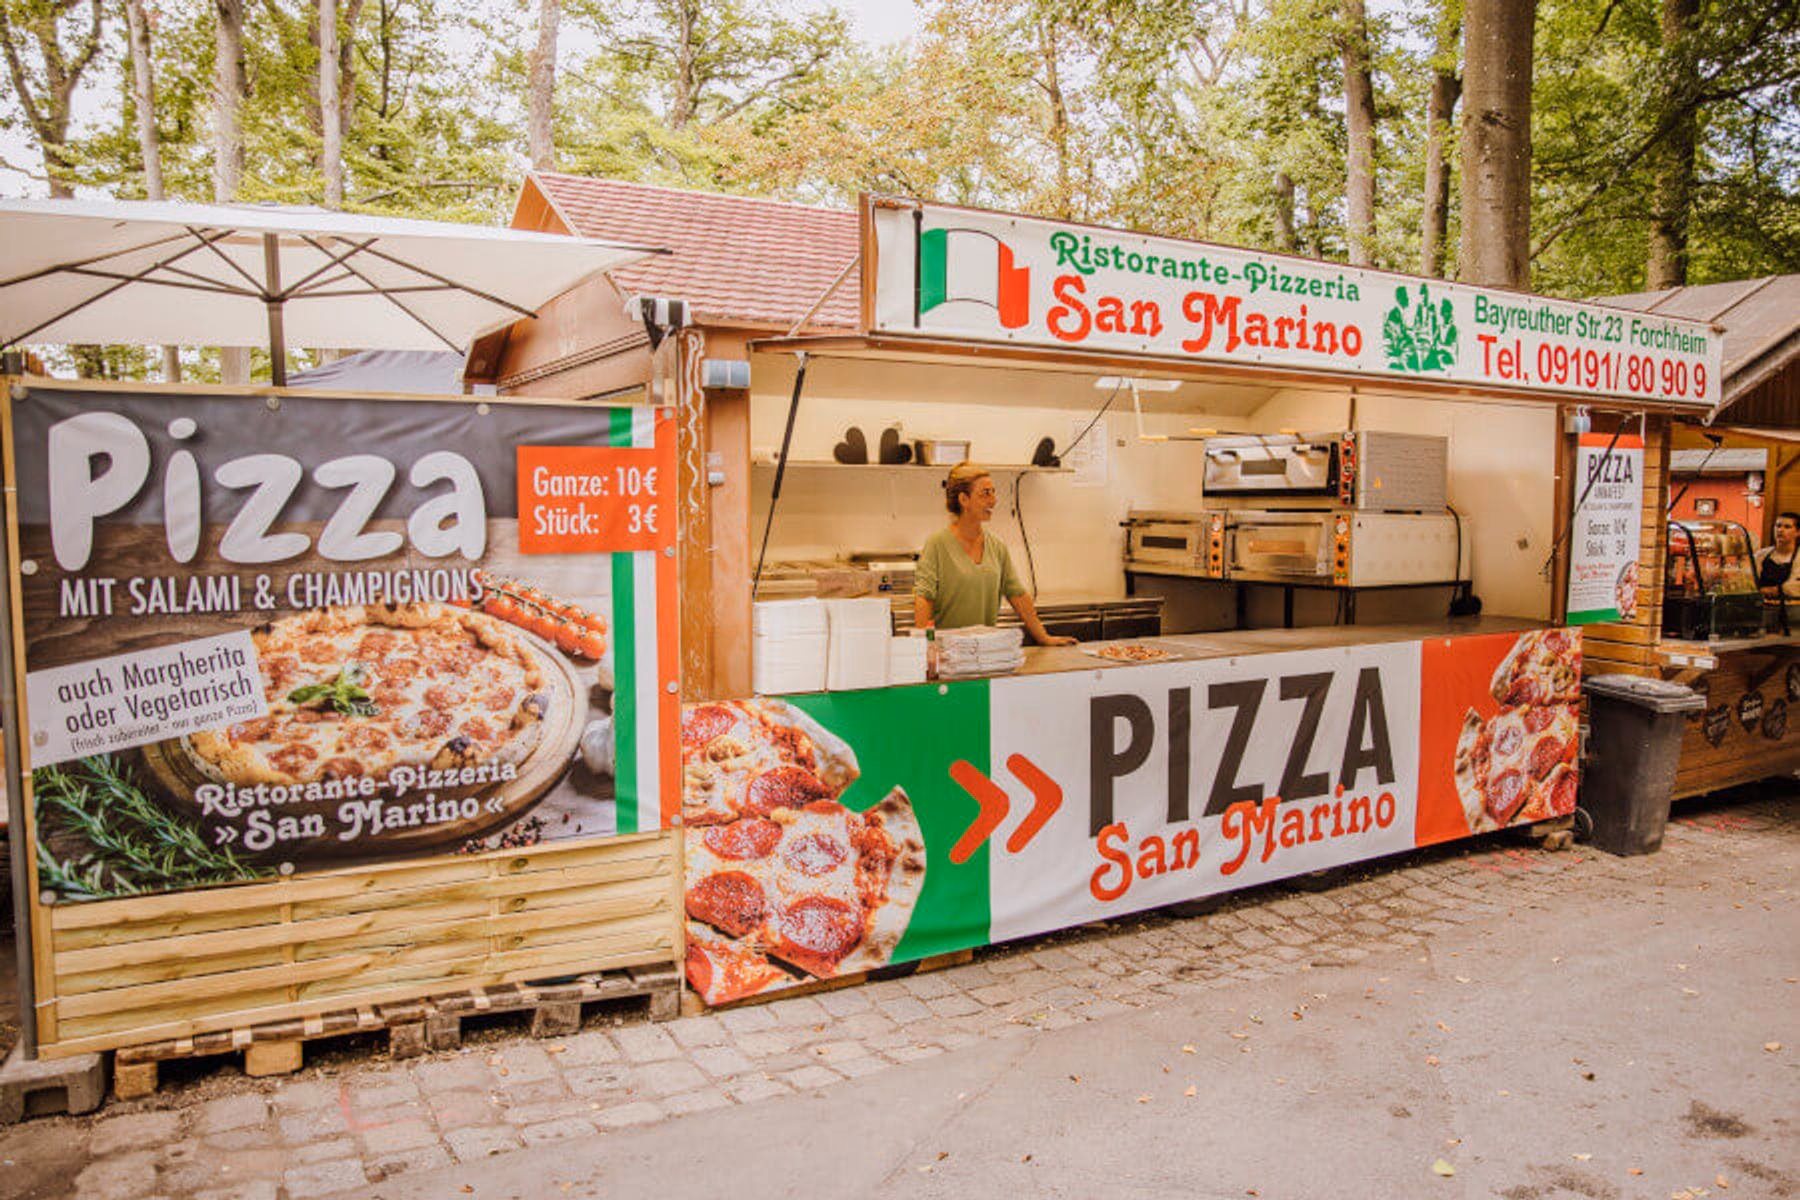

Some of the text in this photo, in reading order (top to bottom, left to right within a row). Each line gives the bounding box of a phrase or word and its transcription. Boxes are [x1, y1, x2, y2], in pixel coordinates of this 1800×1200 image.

[1050, 231, 1361, 302] Ristorante-Pizzeria
[1046, 275, 1362, 357] San Marino
[1474, 295, 1573, 335] Bayreuther
[1630, 320, 1707, 355] Forchheim
[1628, 354, 1654, 393] 80
[1661, 359, 1687, 397] 90
[1694, 363, 1706, 398] 9
[48, 411, 487, 572] Pizza
[533, 466, 657, 496] Ganze: 10€
[1588, 453, 1633, 483] PIZZA
[533, 502, 658, 535] Stück: 3€
[60, 568, 485, 617] MIT SALAMI & CHAMPIGNONS
[58, 647, 246, 703] auch Margherita
[65, 670, 253, 733] oder Vegetarisch
[1090, 667, 1395, 839] PIZZA
[195, 758, 517, 817] Ristorante-Pizzeria
[244, 809, 326, 850] San
[338, 794, 479, 841] Marino
[1089, 784, 1396, 901] San Marino
